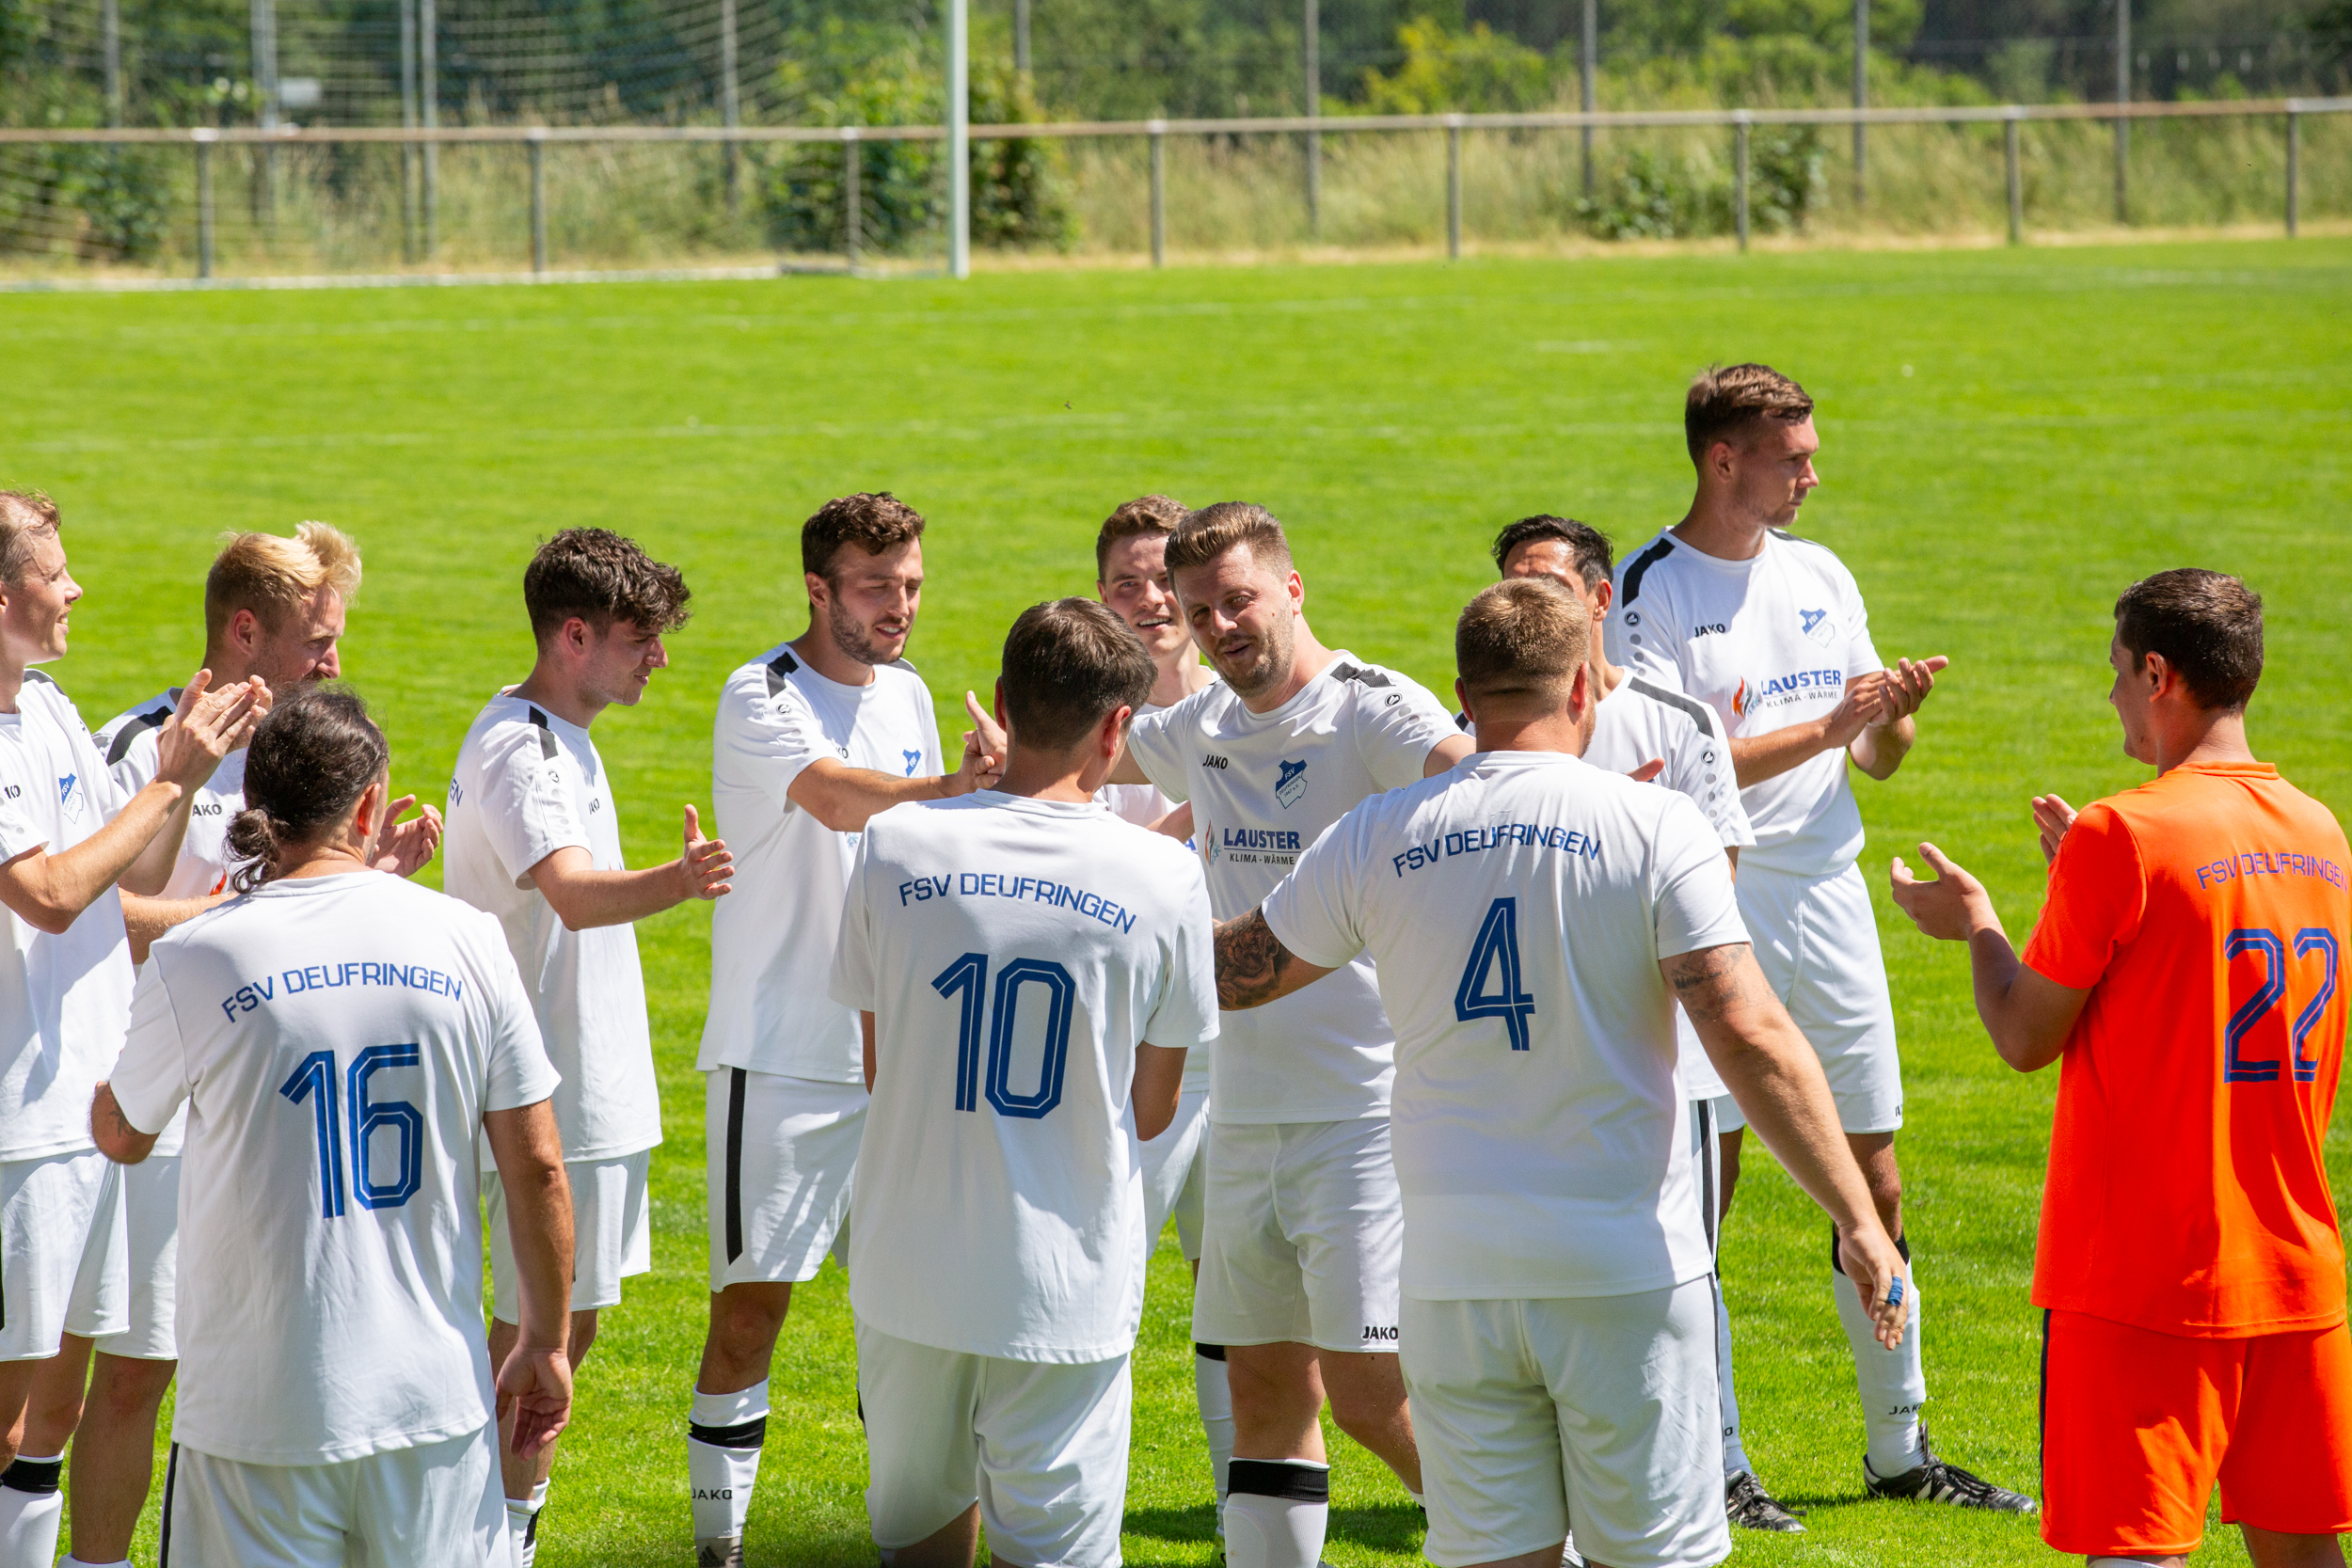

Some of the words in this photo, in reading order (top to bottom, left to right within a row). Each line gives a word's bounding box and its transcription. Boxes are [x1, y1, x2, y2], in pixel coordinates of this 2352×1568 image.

[1694, 624, 1725, 638] JAKO
[1761, 670, 1841, 696] LAUSTER
[1766, 694, 1802, 708] KLIMA
[1808, 689, 1838, 700] WÄRME
[1202, 754, 1229, 769] JAKO
[1284, 767, 1295, 780] FSV
[192, 804, 223, 816] AKO
[1224, 828, 1301, 849] LAUSTER
[1230, 853, 1257, 863] KLIMA
[1263, 853, 1295, 865] WÄRME
[1392, 838, 1440, 878] FSV
[1444, 823, 1601, 861] DEUFRINGEN
[2196, 855, 2237, 890] FSV
[2240, 852, 2348, 895] DEUFRINGEN
[898, 874, 951, 907] FSV
[960, 873, 1136, 935] DEUFRINGEN
[1454, 896, 1534, 1052] 4
[221, 975, 273, 1023] FSV
[282, 962, 462, 1001] DEUFRINGEN
[2224, 927, 2339, 1084] 22
[930, 952, 1076, 1120] 10
[279, 1042, 423, 1219] 16
[1362, 1325, 1399, 1340] JAKO
[691, 1488, 733, 1500] JAKO
